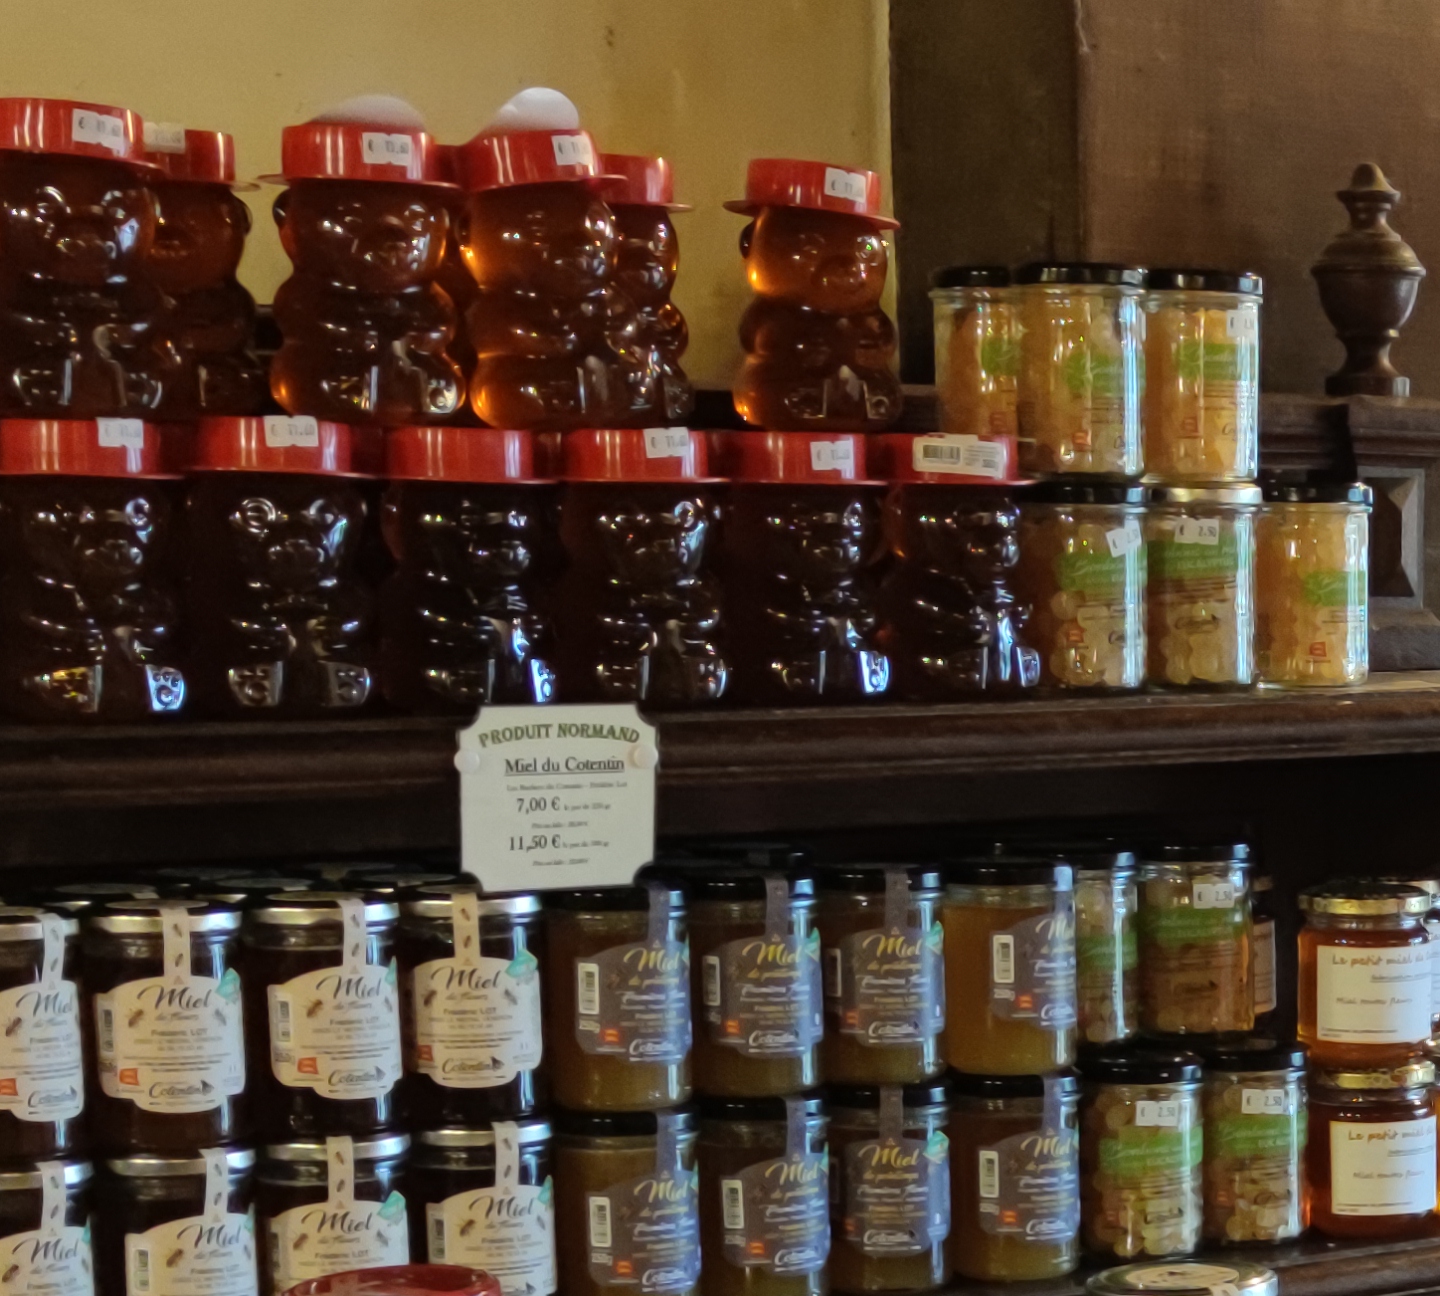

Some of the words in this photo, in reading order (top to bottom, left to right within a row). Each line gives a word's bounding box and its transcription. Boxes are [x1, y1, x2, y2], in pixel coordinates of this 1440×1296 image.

[478, 724, 553, 749] PRODUIT
[557, 723, 641, 744] NORMAND
[505, 757, 538, 773] Miel
[542, 757, 560, 772] du
[565, 756, 626, 772] Cotentin
[516, 798, 547, 815] 7,00
[551, 797, 560, 811] €
[510, 835, 548, 853] 11,50
[552, 835, 560, 849] €
[863, 932, 923, 960] Miel
[1332, 953, 1348, 966] Le
[1350, 952, 1382, 969] petit
[1384, 951, 1413, 966] miel
[317, 975, 382, 999] Miel
[431, 966, 500, 990] Miel
[16, 991, 74, 1015] Miel
[138, 985, 212, 1009] Miel
[1348, 1129, 1364, 1142] Le
[1367, 1128, 1398, 1145] petit
[1400, 1126, 1423, 1141] miel
[858, 1144, 919, 1168] Miel
[469, 1195, 534, 1219] Miel
[302, 1209, 372, 1234] Miel
[177, 1223, 241, 1248] Miel
[12, 1238, 80, 1263] Miel
